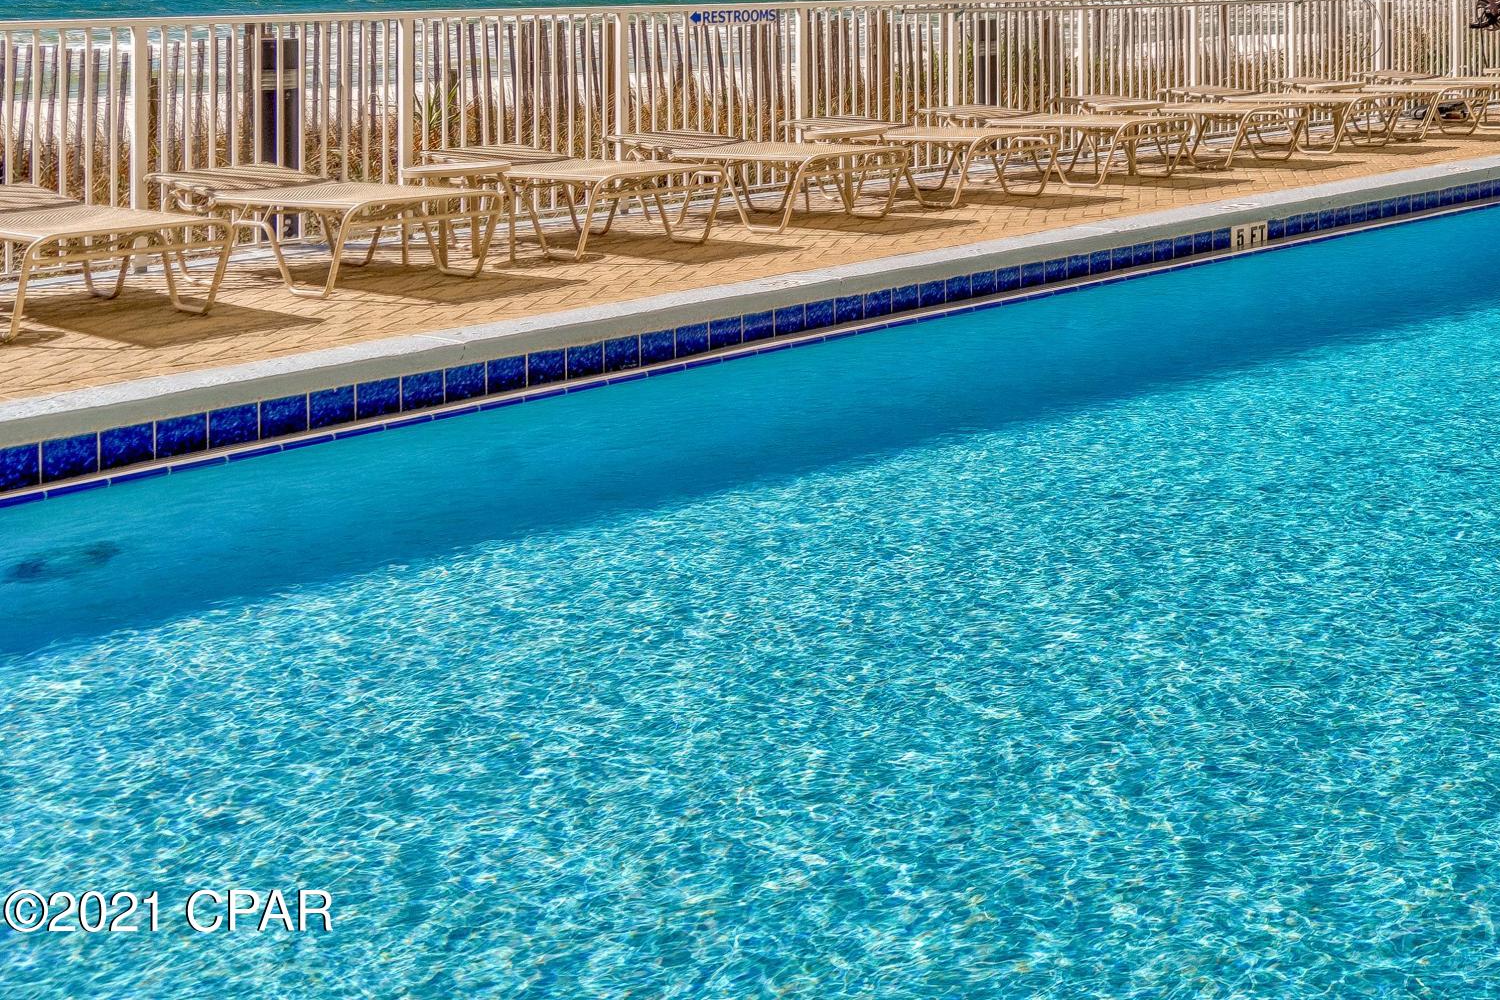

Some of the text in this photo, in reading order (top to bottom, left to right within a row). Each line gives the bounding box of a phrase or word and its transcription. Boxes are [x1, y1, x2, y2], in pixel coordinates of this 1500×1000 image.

[702, 9, 776, 23] RESTROOMS
[1236, 225, 1266, 247] 5 FT
